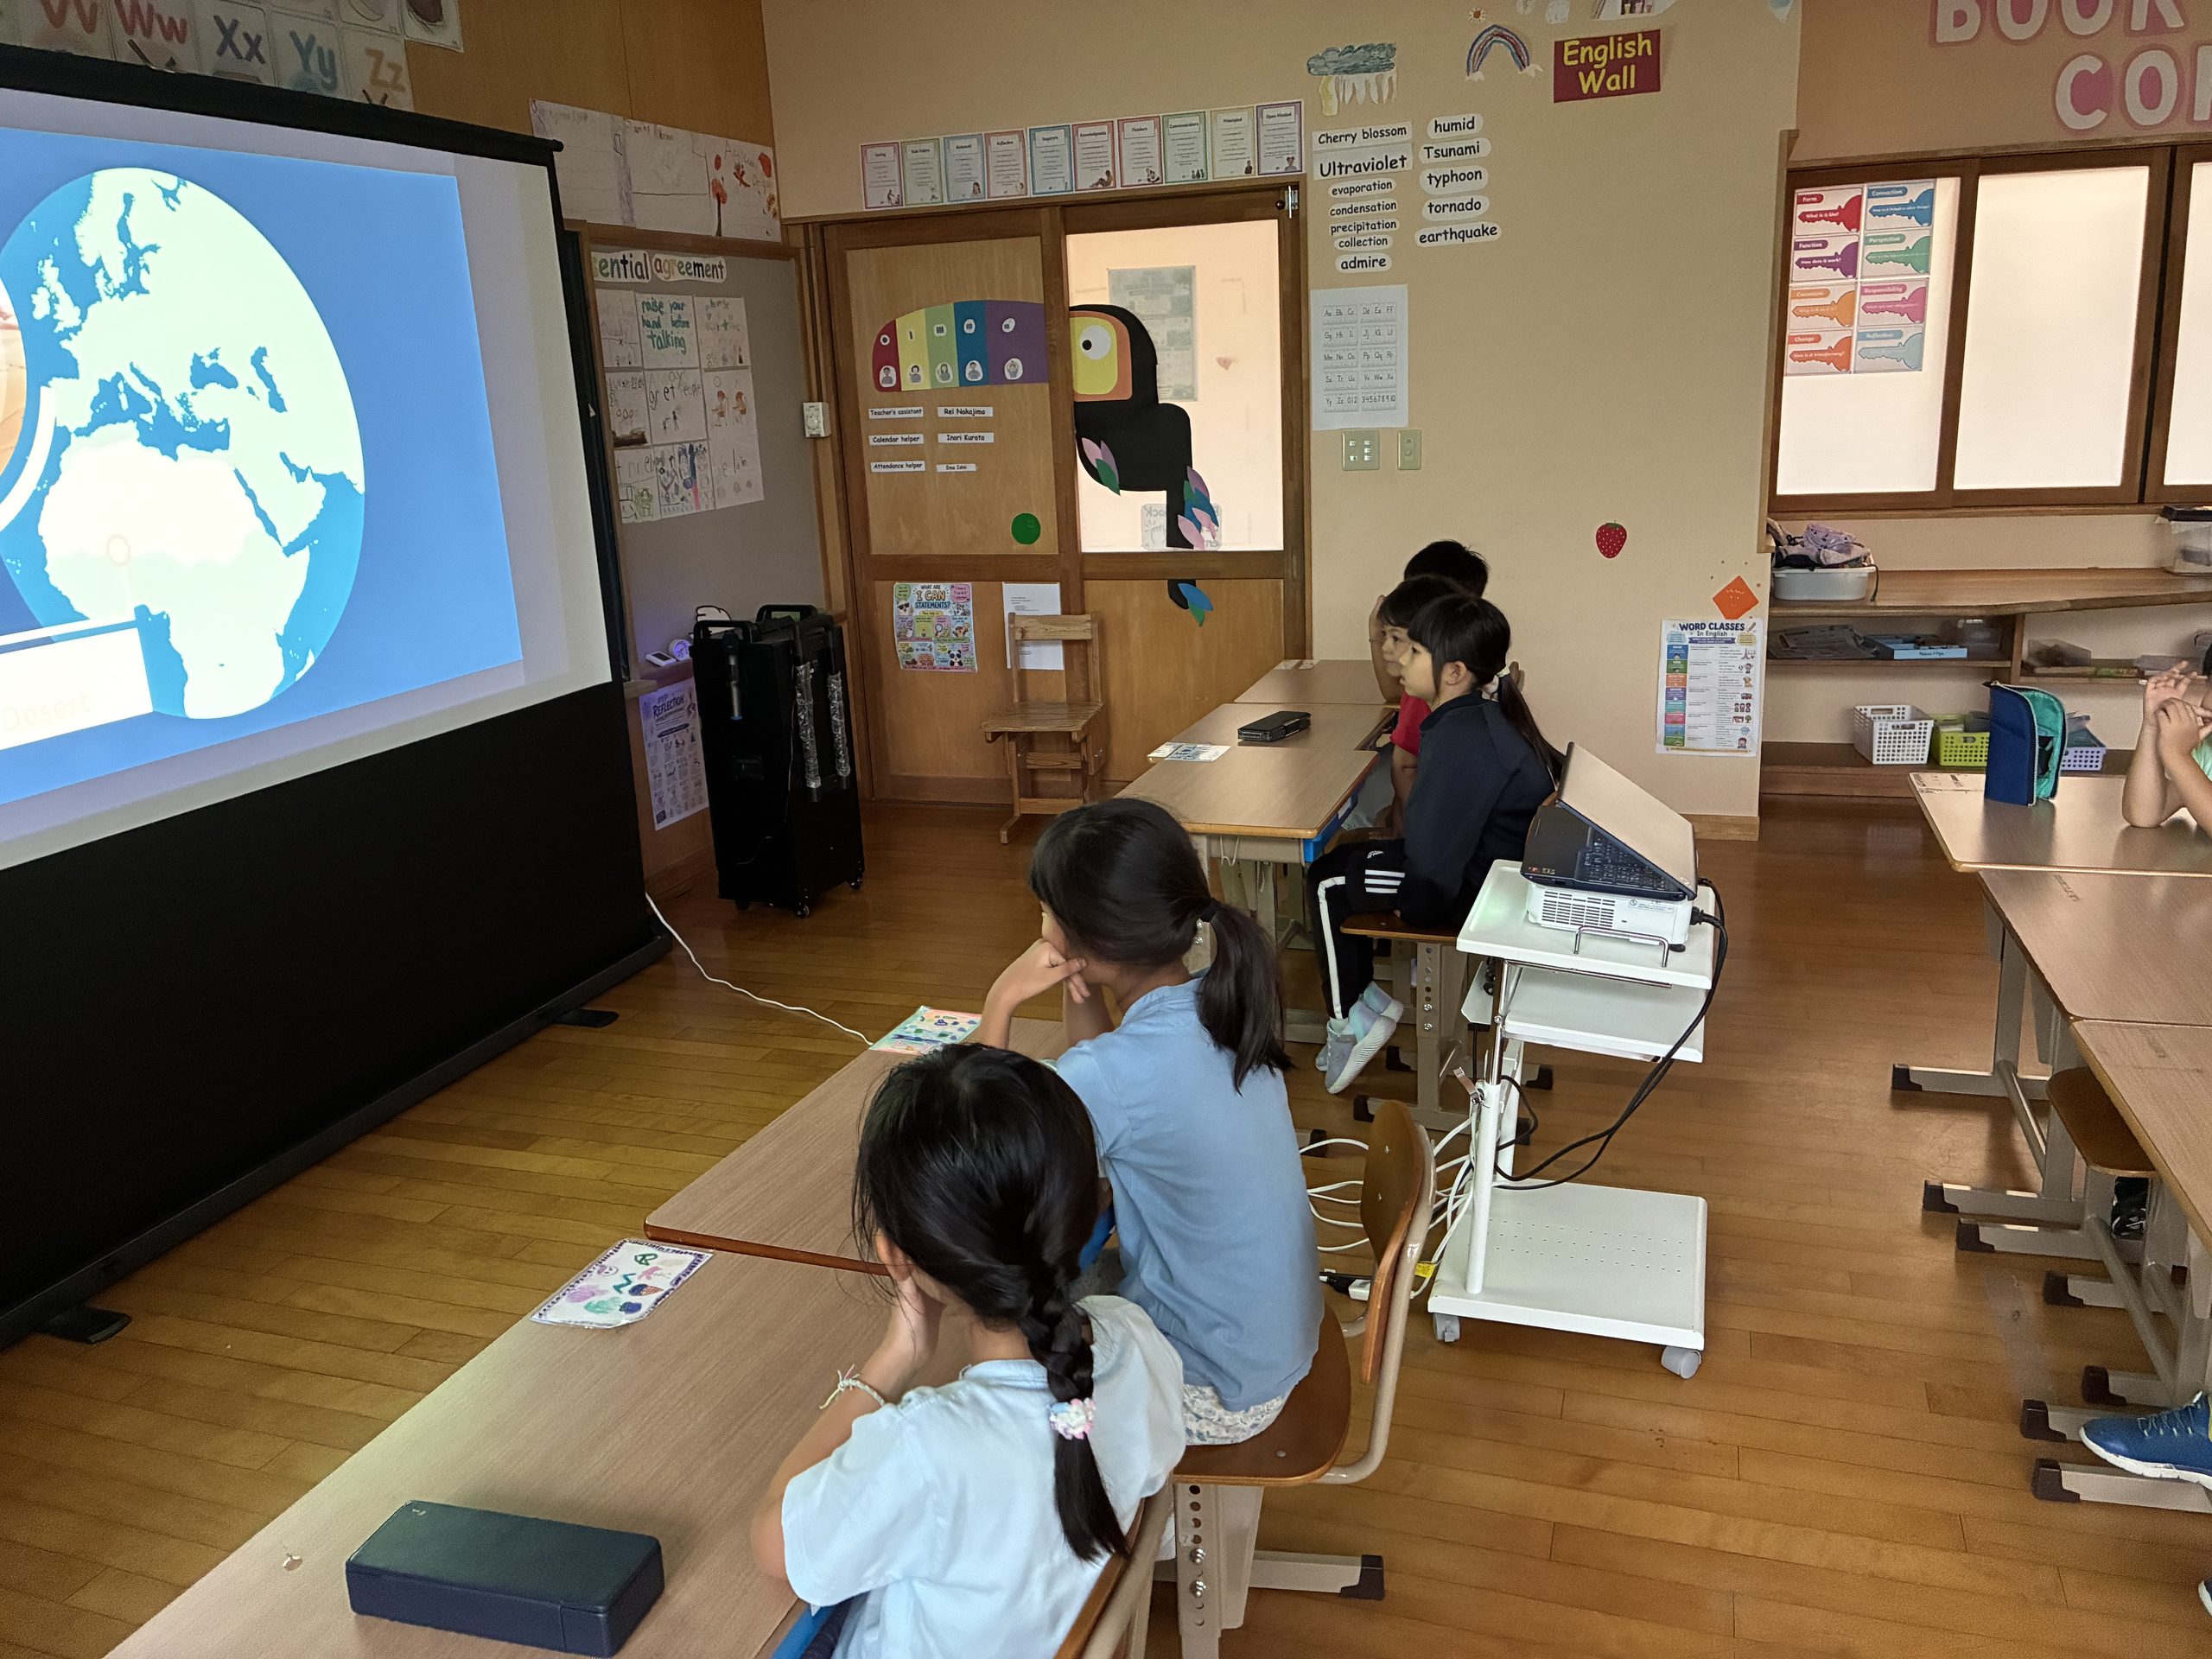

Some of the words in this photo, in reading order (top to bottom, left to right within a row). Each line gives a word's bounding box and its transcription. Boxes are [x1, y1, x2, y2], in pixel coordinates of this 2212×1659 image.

[213, 16, 265, 65] Xx
[289, 30, 338, 92] Yy
[365, 48, 404, 92] Zz
[1563, 34, 1652, 69] English
[1579, 66, 1636, 94] Wall
[1433, 116, 1476, 134] humid
[1318, 131, 1357, 145] Cherry
[1362, 124, 1407, 139] blossom
[1424, 142, 1480, 159] Tsunami
[1319, 155, 1408, 178] Ultraviolet
[1427, 168, 1483, 188] typhoon
[1332, 180, 1393, 196] evaporation
[1330, 200, 1397, 217] condensation
[1427, 199, 1482, 214] tornado
[1330, 219, 1397, 235] precipitation
[1419, 224, 1498, 245] earthquake
[1338, 236, 1388, 249] collection
[655, 258, 725, 280] agreement
[1340, 256, 1387, 270] admire
[641, 298, 664, 315] raise
[669, 299, 686, 313] your
[642, 315, 662, 329] hand
[648, 330, 687, 355] talking
[957, 408, 986, 416] Nakajima
[906, 461, 923, 470] helper
[916, 590, 923, 601] I
[925, 589, 946, 601] CAN
[1679, 622, 1707, 631] WORD
[1708, 622, 1745, 632] CLASSES
[2, 691, 91, 732] Desert
[653, 693, 684, 718] REFLECTION
